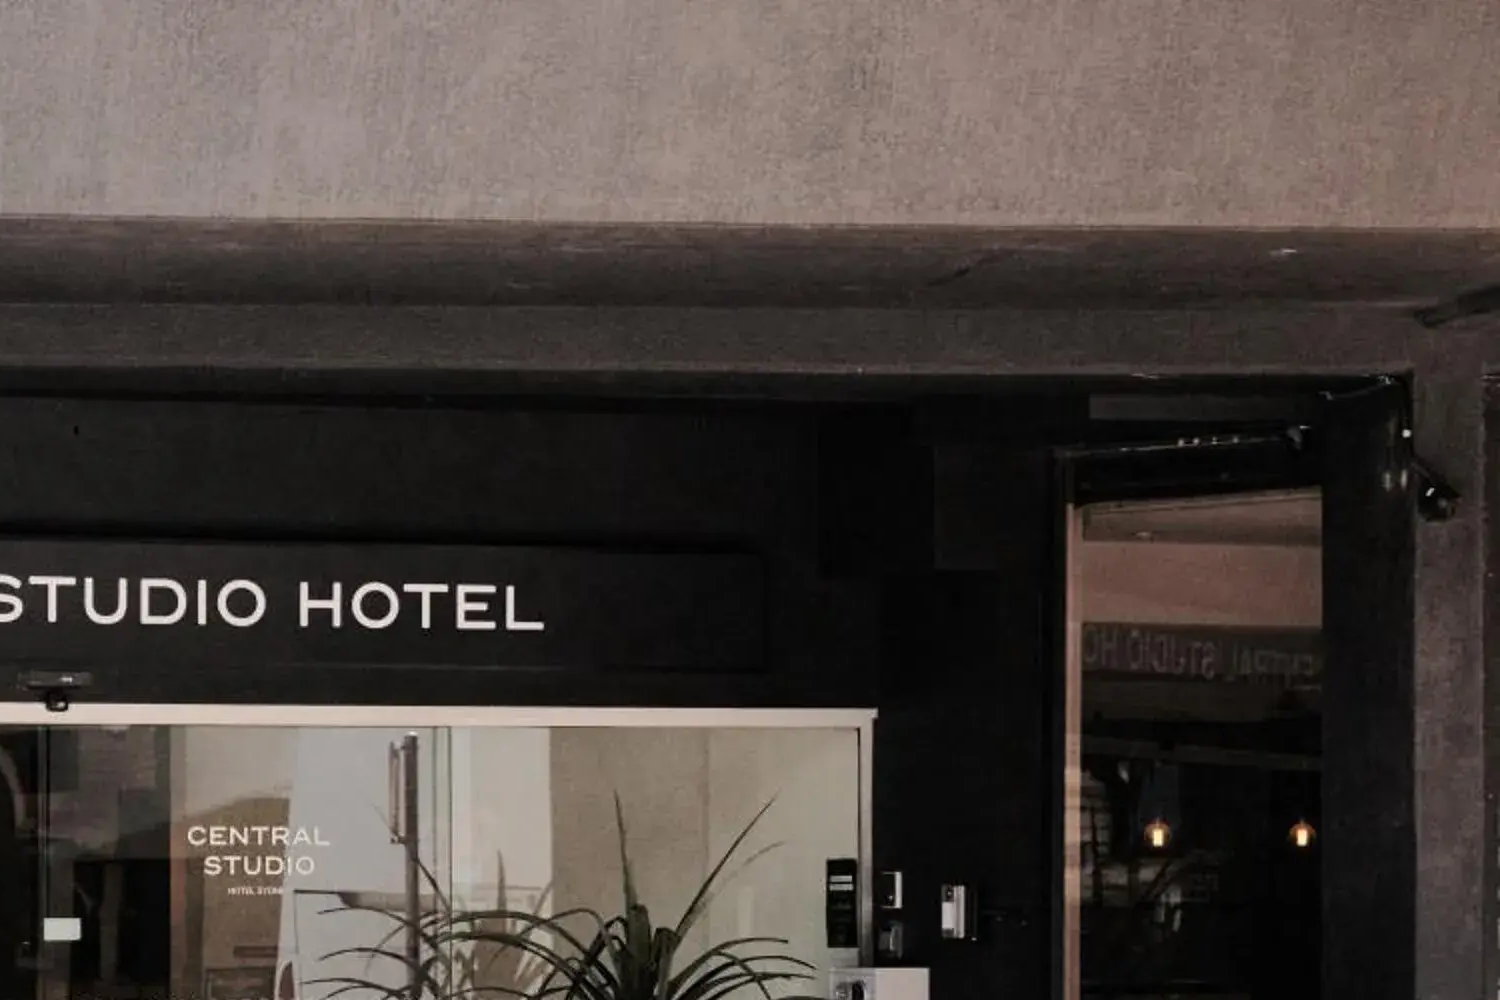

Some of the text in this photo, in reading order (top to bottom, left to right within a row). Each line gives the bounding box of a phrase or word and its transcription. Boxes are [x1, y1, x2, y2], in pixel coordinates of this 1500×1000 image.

[299, 581, 545, 631] HOTEL
[187, 825, 331, 847] CENTRAL
[203, 855, 315, 876] STUDIO
